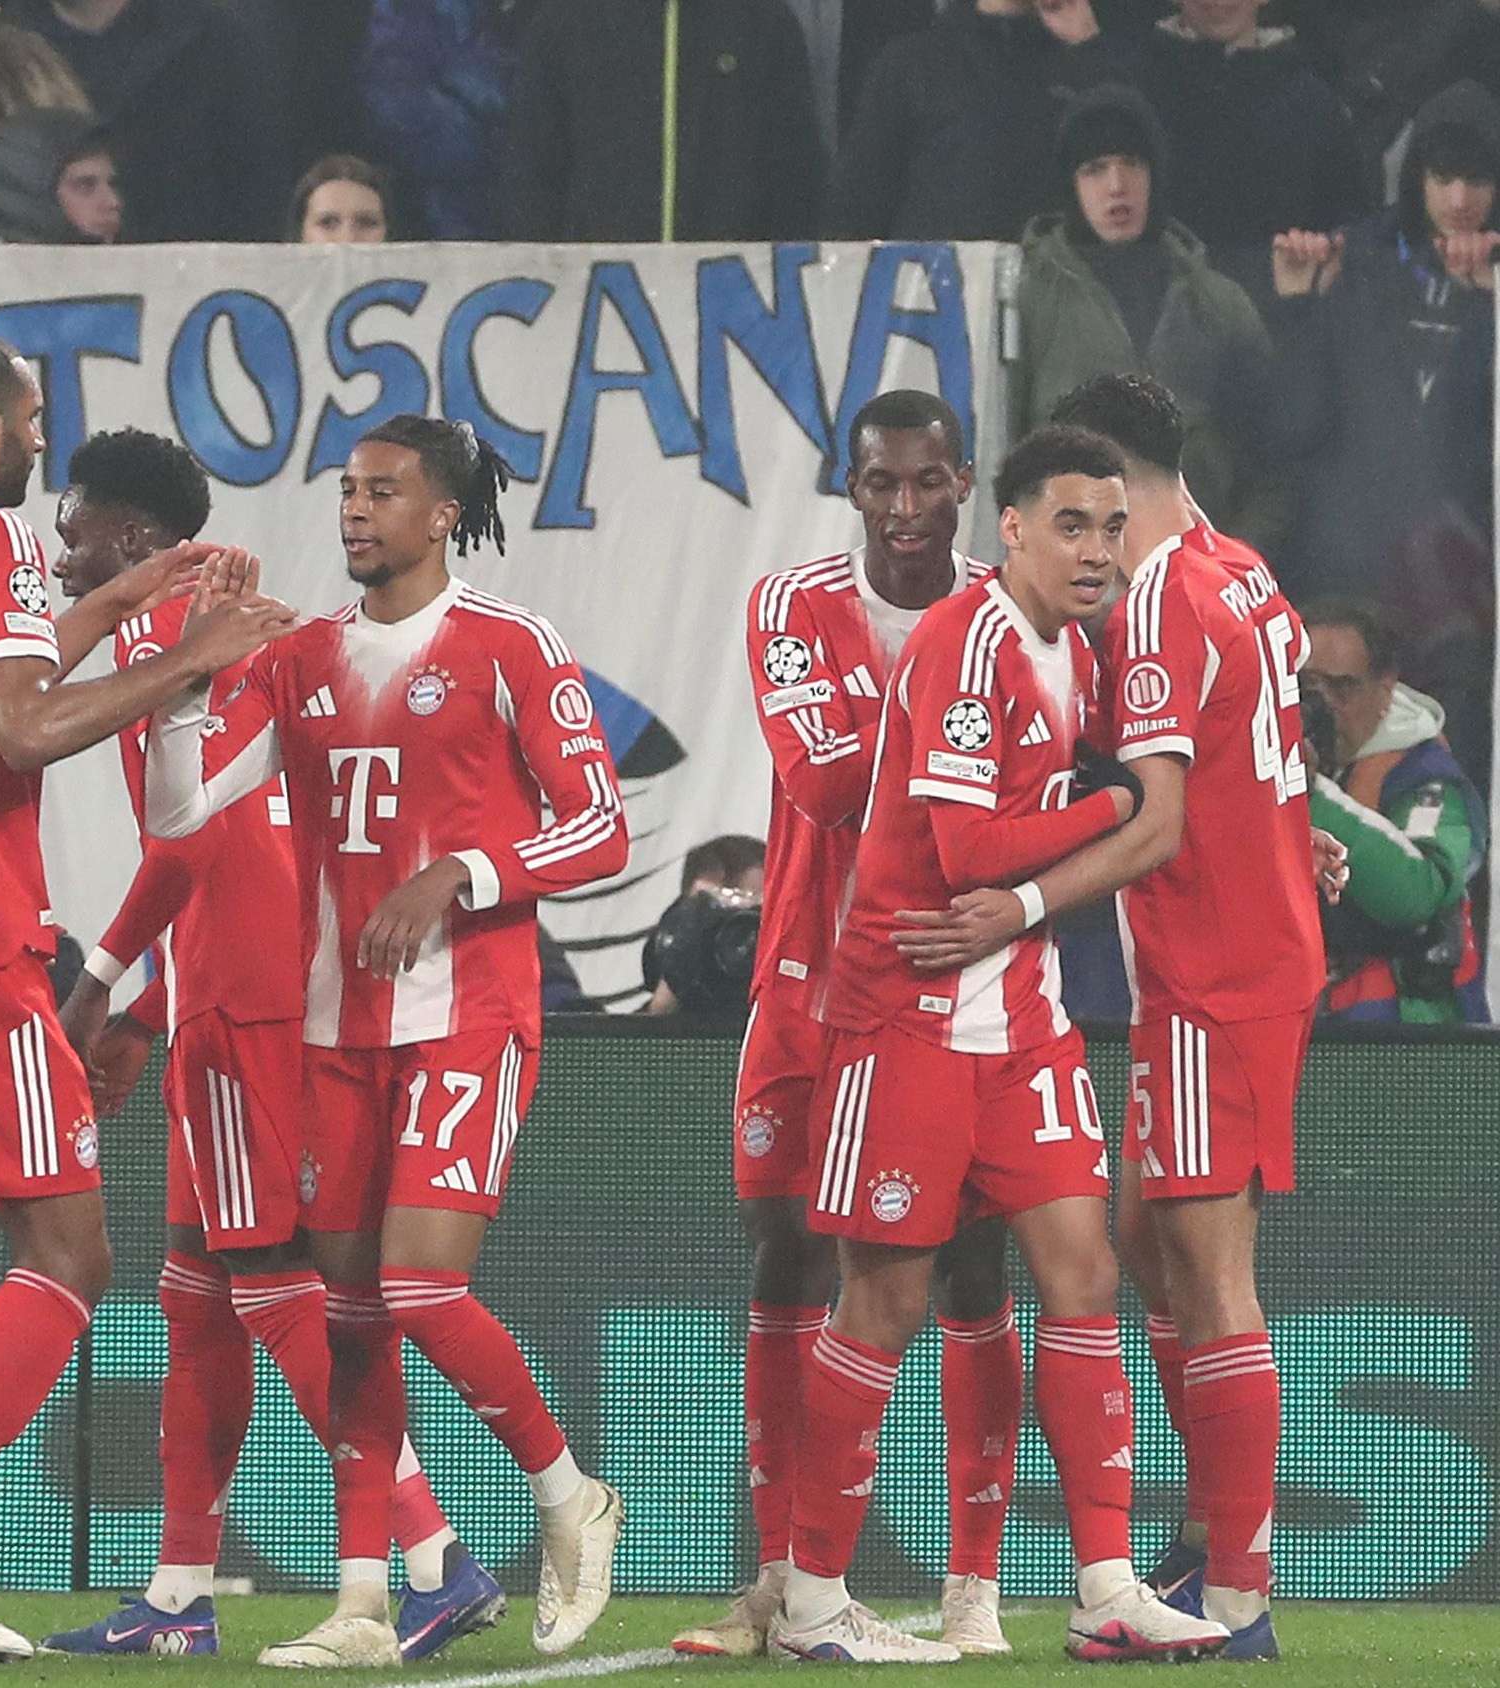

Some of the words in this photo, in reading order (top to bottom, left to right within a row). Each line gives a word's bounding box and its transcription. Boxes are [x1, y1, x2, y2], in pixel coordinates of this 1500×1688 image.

[1122, 716, 1179, 740] Allianz
[400, 1069, 483, 1151] 17
[1028, 1066, 1105, 1143] 10
